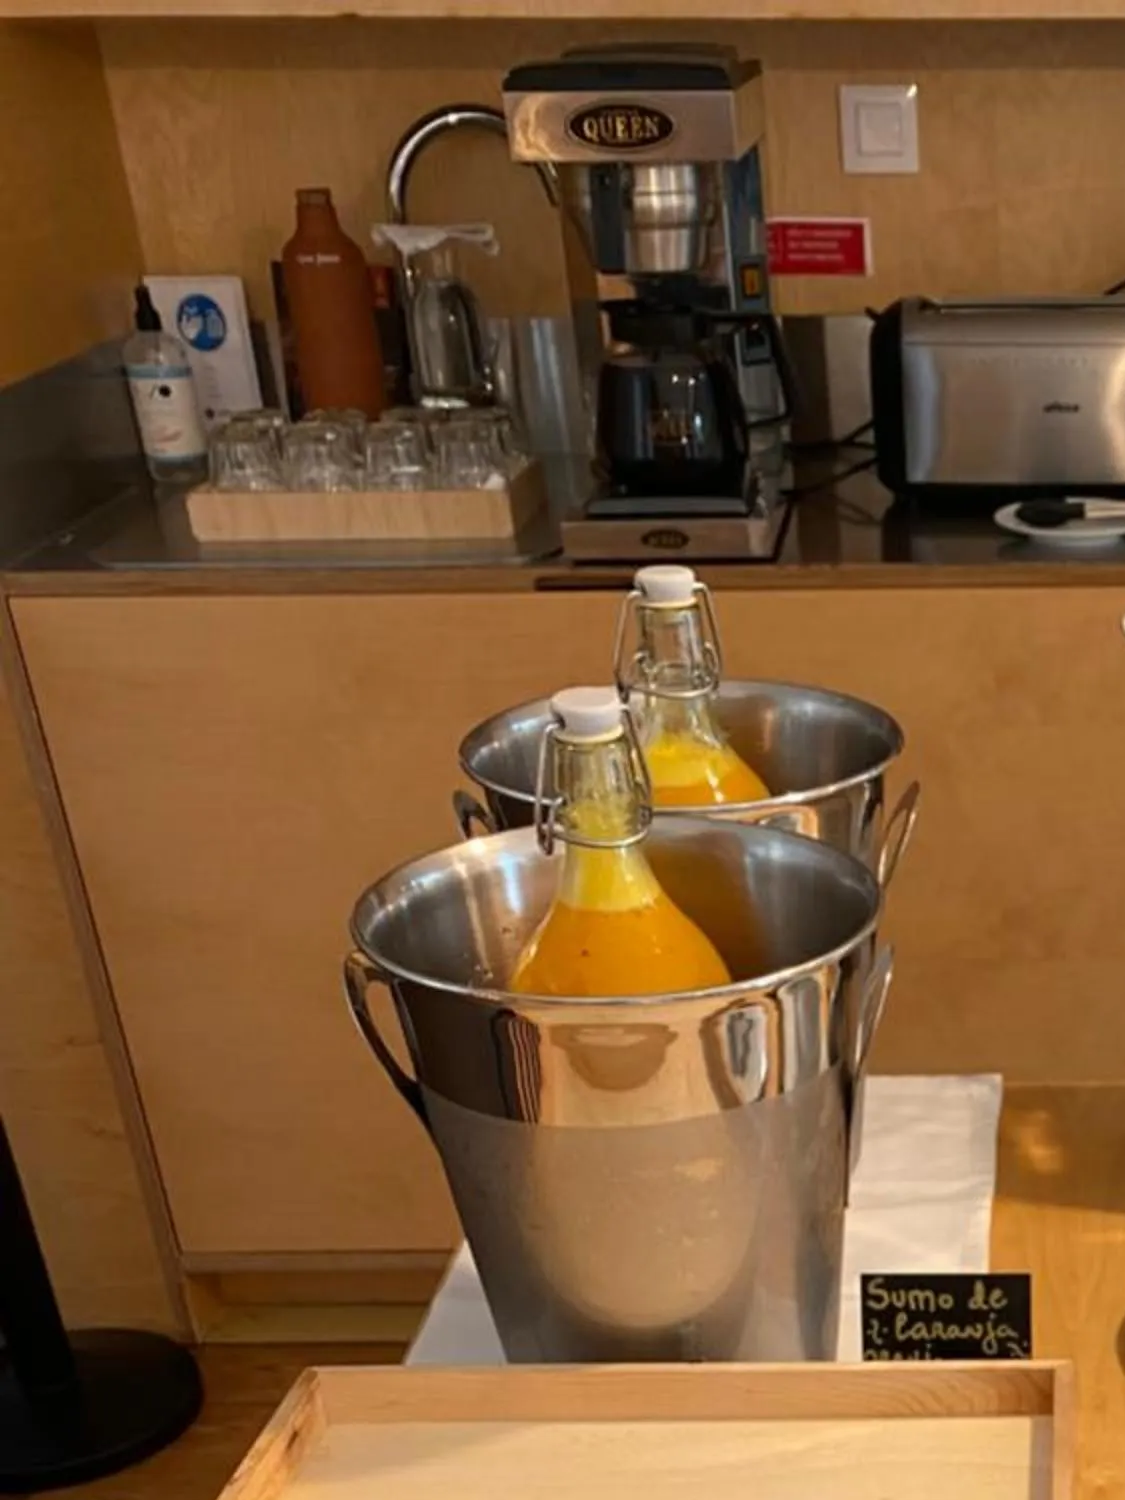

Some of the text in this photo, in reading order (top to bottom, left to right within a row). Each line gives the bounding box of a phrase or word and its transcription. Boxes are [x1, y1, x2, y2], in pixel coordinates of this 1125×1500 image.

[582, 115, 661, 142] QUEEN
[866, 1277, 1008, 1312] Sumo de
